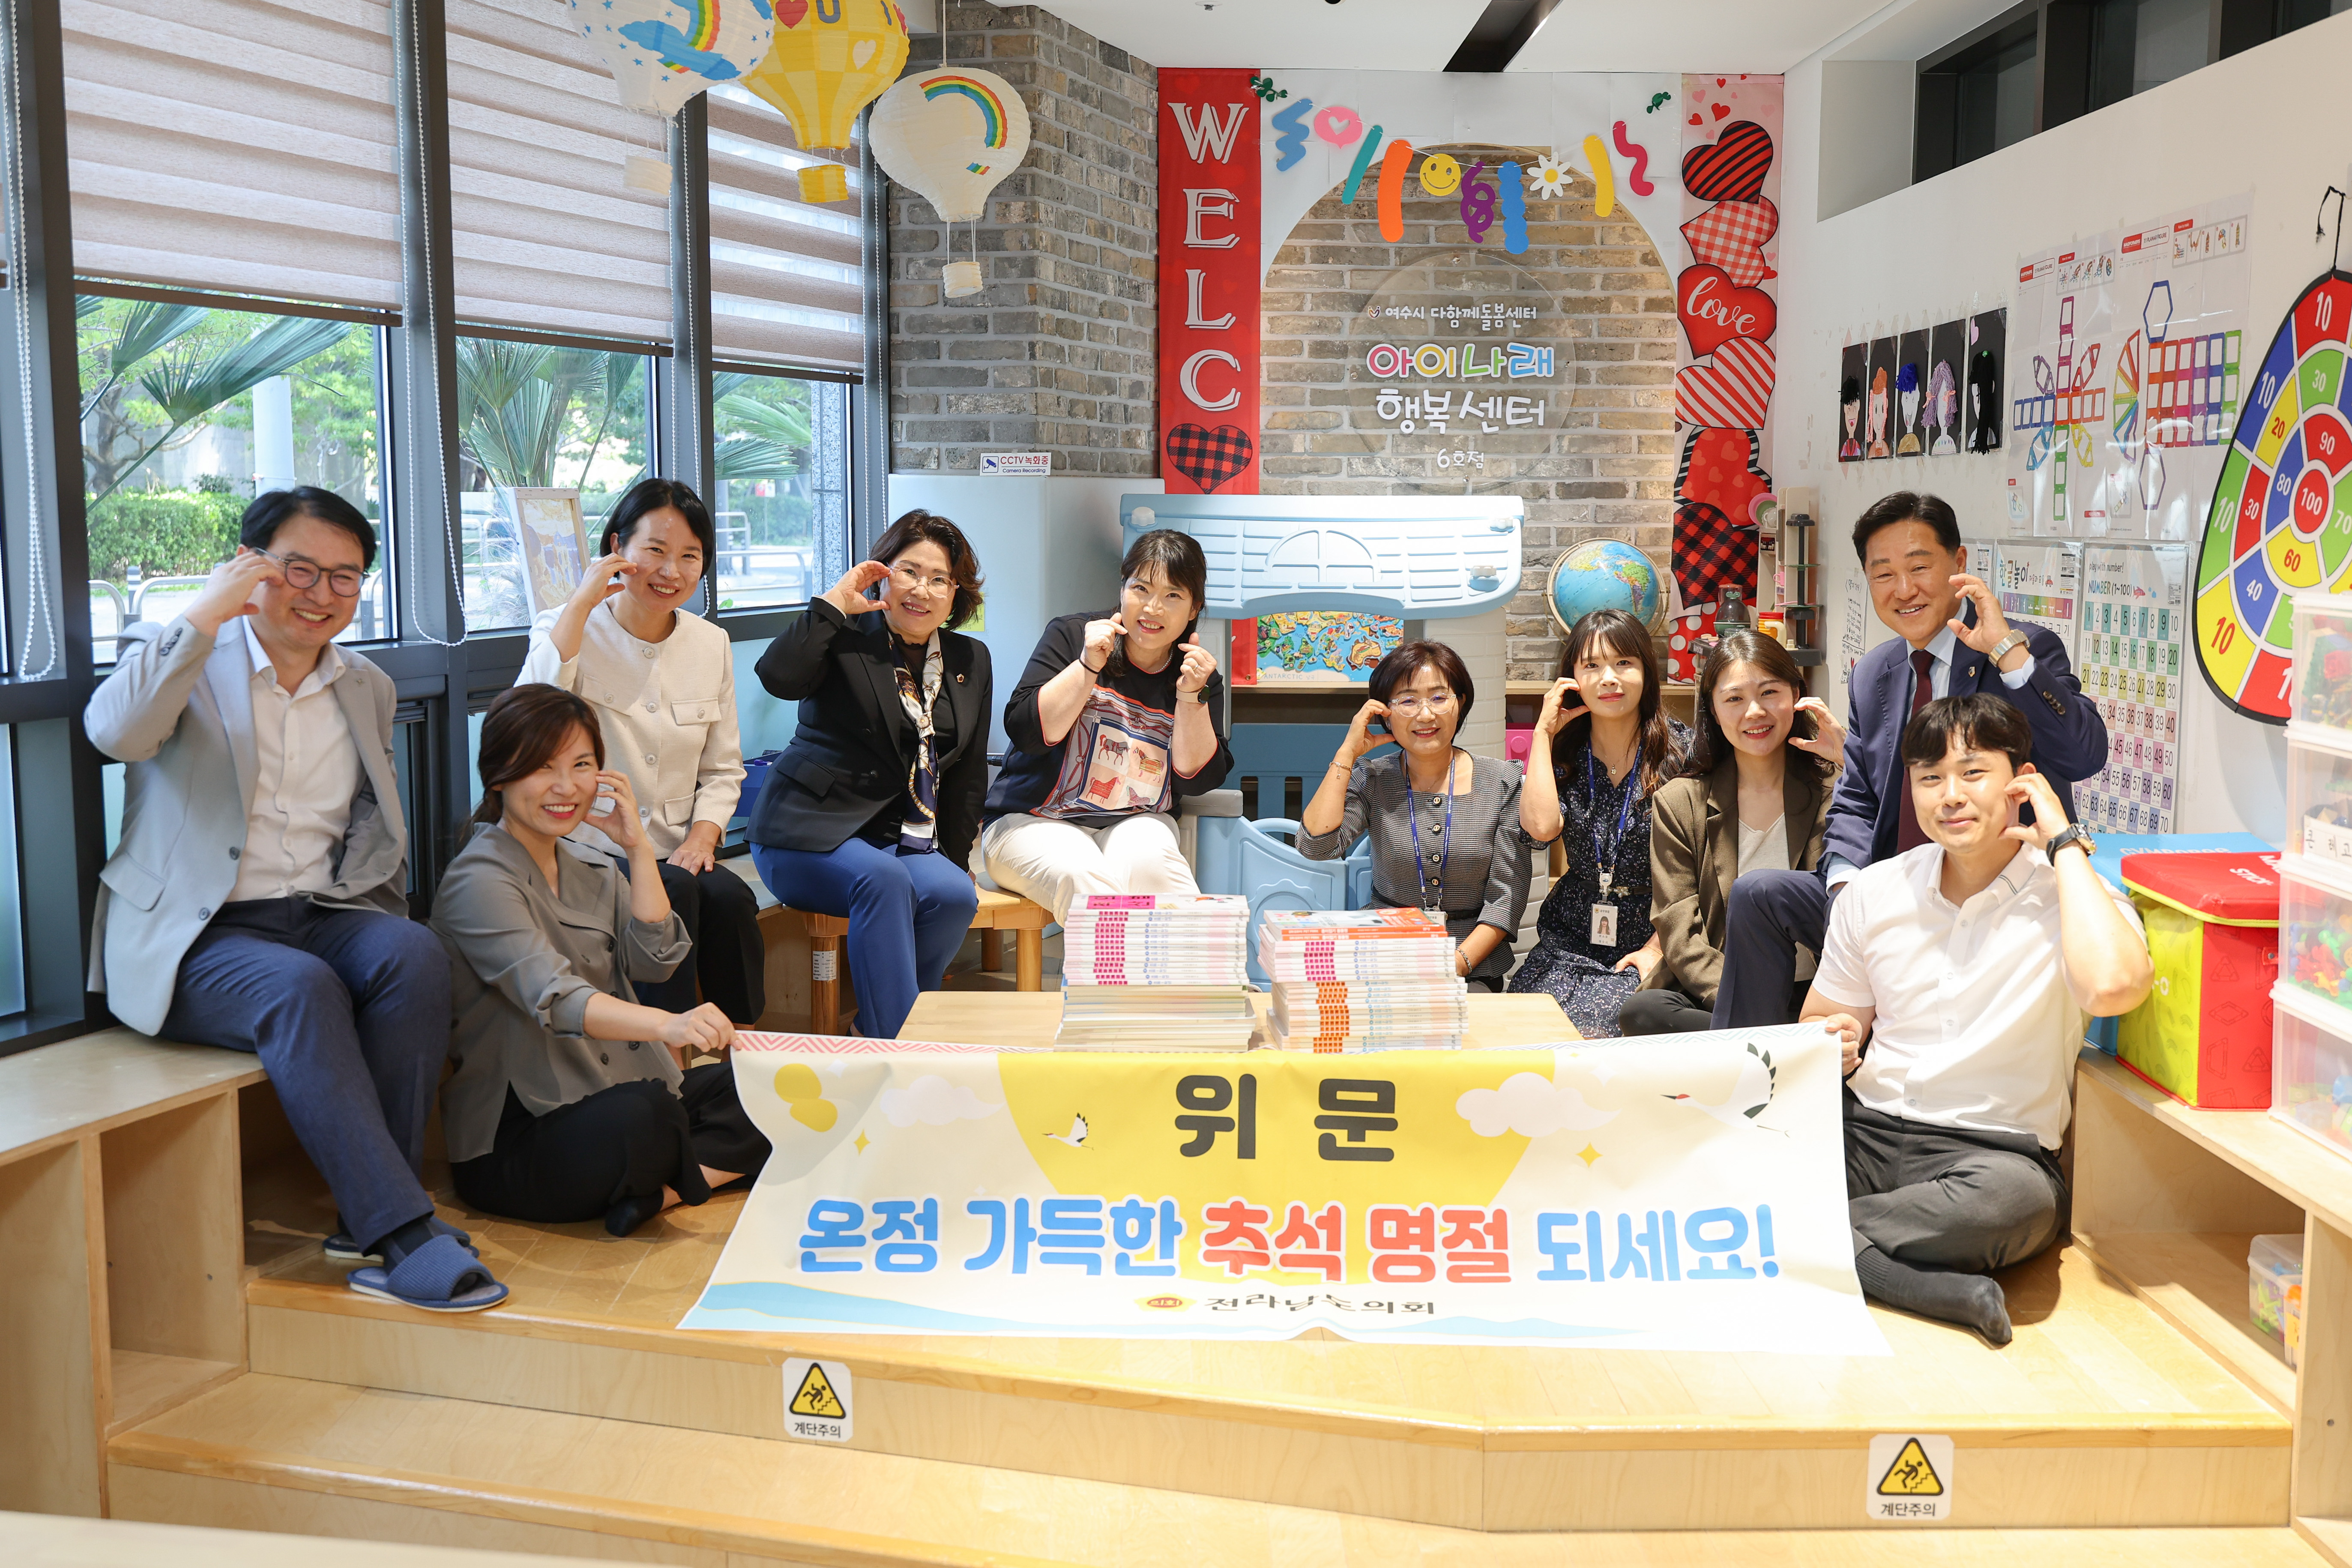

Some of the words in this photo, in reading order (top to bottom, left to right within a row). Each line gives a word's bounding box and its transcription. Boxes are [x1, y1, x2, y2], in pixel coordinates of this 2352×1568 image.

[1385, 306, 1424, 320] 여수시
[1430, 303, 1537, 331] 다함께돌봄센터
[1686, 276, 1756, 335] love
[2315, 291, 2332, 332] 10
[1366, 342, 1555, 378] 아이나래
[2257, 371, 2276, 409] 10
[2312, 369, 2327, 392] 30
[2271, 416, 2285, 439] 20
[2319, 431, 2336, 455] 90
[1436, 448, 1484, 470] 6호점
[2276, 473, 2292, 496] 80
[2244, 498, 2260, 520] 30
[2301, 487, 2323, 515] 100
[2213, 497, 2235, 533] 10
[2334, 509, 2352, 535] 70
[2089, 562, 2097, 572] play
[2097, 562, 2106, 572] with
[2106, 562, 2124, 573] number!
[2284, 548, 2301, 572] 60
[1999, 559, 2028, 590] 한글놀이
[2088, 580, 2111, 595] NUMBER
[2246, 579, 2263, 601] 40
[2088, 607, 2090, 621] 1
[2096, 608, 2099, 622] 2
[2104, 609, 2108, 623] 3
[2114, 610, 2118, 624] 4
[2124, 611, 2128, 625] 5
[2133, 612, 2136, 626] 6
[2142, 613, 2145, 627] 7
[2151, 614, 2154, 628] 8
[2162, 615, 2166, 630] 9
[2171, 616, 2178, 631] 10
[2211, 616, 2235, 655] 10
[2086, 638, 2089, 652] 11
[2094, 640, 2099, 653] 12
[2103, 640, 2108, 655] 13
[2112, 642, 2118, 656] 14
[2122, 643, 2127, 658] 15
[2131, 644, 2136, 659] 16
[2140, 646, 2145, 660] 17
[2149, 647, 2154, 662] 18
[2159, 648, 2165, 663] 19
[2169, 649, 2177, 665] 20
[2083, 669, 2089, 683] 21
[2092, 670, 2098, 685] 22
[2101, 672, 2108, 687] 23
[2110, 674, 2117, 688] 24
[2119, 676, 2126, 690] 25
[2129, 677, 2135, 691] 26
[2138, 678, 2144, 693] 27
[2147, 680, 2154, 695] 28
[2157, 682, 2165, 697] 29
[2168, 683, 2175, 699] 30
[2277, 666, 2292, 708] 1
[2099, 703, 2106, 718] 33
[2108, 706, 2115, 720] 34
[2117, 707, 2125, 722] 35
[2127, 709, 2134, 724] 36
[2137, 711, 2143, 726] 37
[2145, 713, 2153, 728] 38
[2155, 715, 2163, 730] 39
[2166, 718, 2174, 733] 40
[2115, 740, 2122, 754] 45
[2125, 742, 2132, 756] 46
[2135, 744, 2142, 759] 47
[2144, 746, 2152, 761] 48
[2155, 748, 2162, 764] 49
[2165, 751, 2172, 766] 50
[2102, 769, 2110, 783] 54
[2112, 771, 2119, 786] 55
[2122, 774, 2130, 789] 56
[2133, 776, 2140, 791] 57
[2143, 778, 2150, 794] 58
[2153, 781, 2161, 797] 59
[2163, 784, 2171, 799] 60
[2075, 791, 2080, 806] 61
[2082, 794, 2089, 808] 62
[2091, 796, 2098, 811] 63
[2100, 799, 2107, 814] 64
[2109, 802, 2116, 817] 65
[2119, 805, 2127, 820] 66
[2130, 808, 2137, 823] 67
[2140, 811, 2147, 826] 68
[2150, 814, 2157, 829] 69
[2161, 817, 2168, 832] 70
[1175, 1073, 1257, 1160] 위
[1314, 1078, 1398, 1162] 문
[799, 1198, 939, 1274] 온정
[964, 1197, 1182, 1277] 가득한
[1203, 1201, 1346, 1283] 추석
[1369, 1203, 1512, 1283] 명절
[1536, 1204, 1780, 1283] 되세요!
[794, 1421, 841, 1439] 계단주의
[1881, 1502, 1936, 1517] 계단주의
